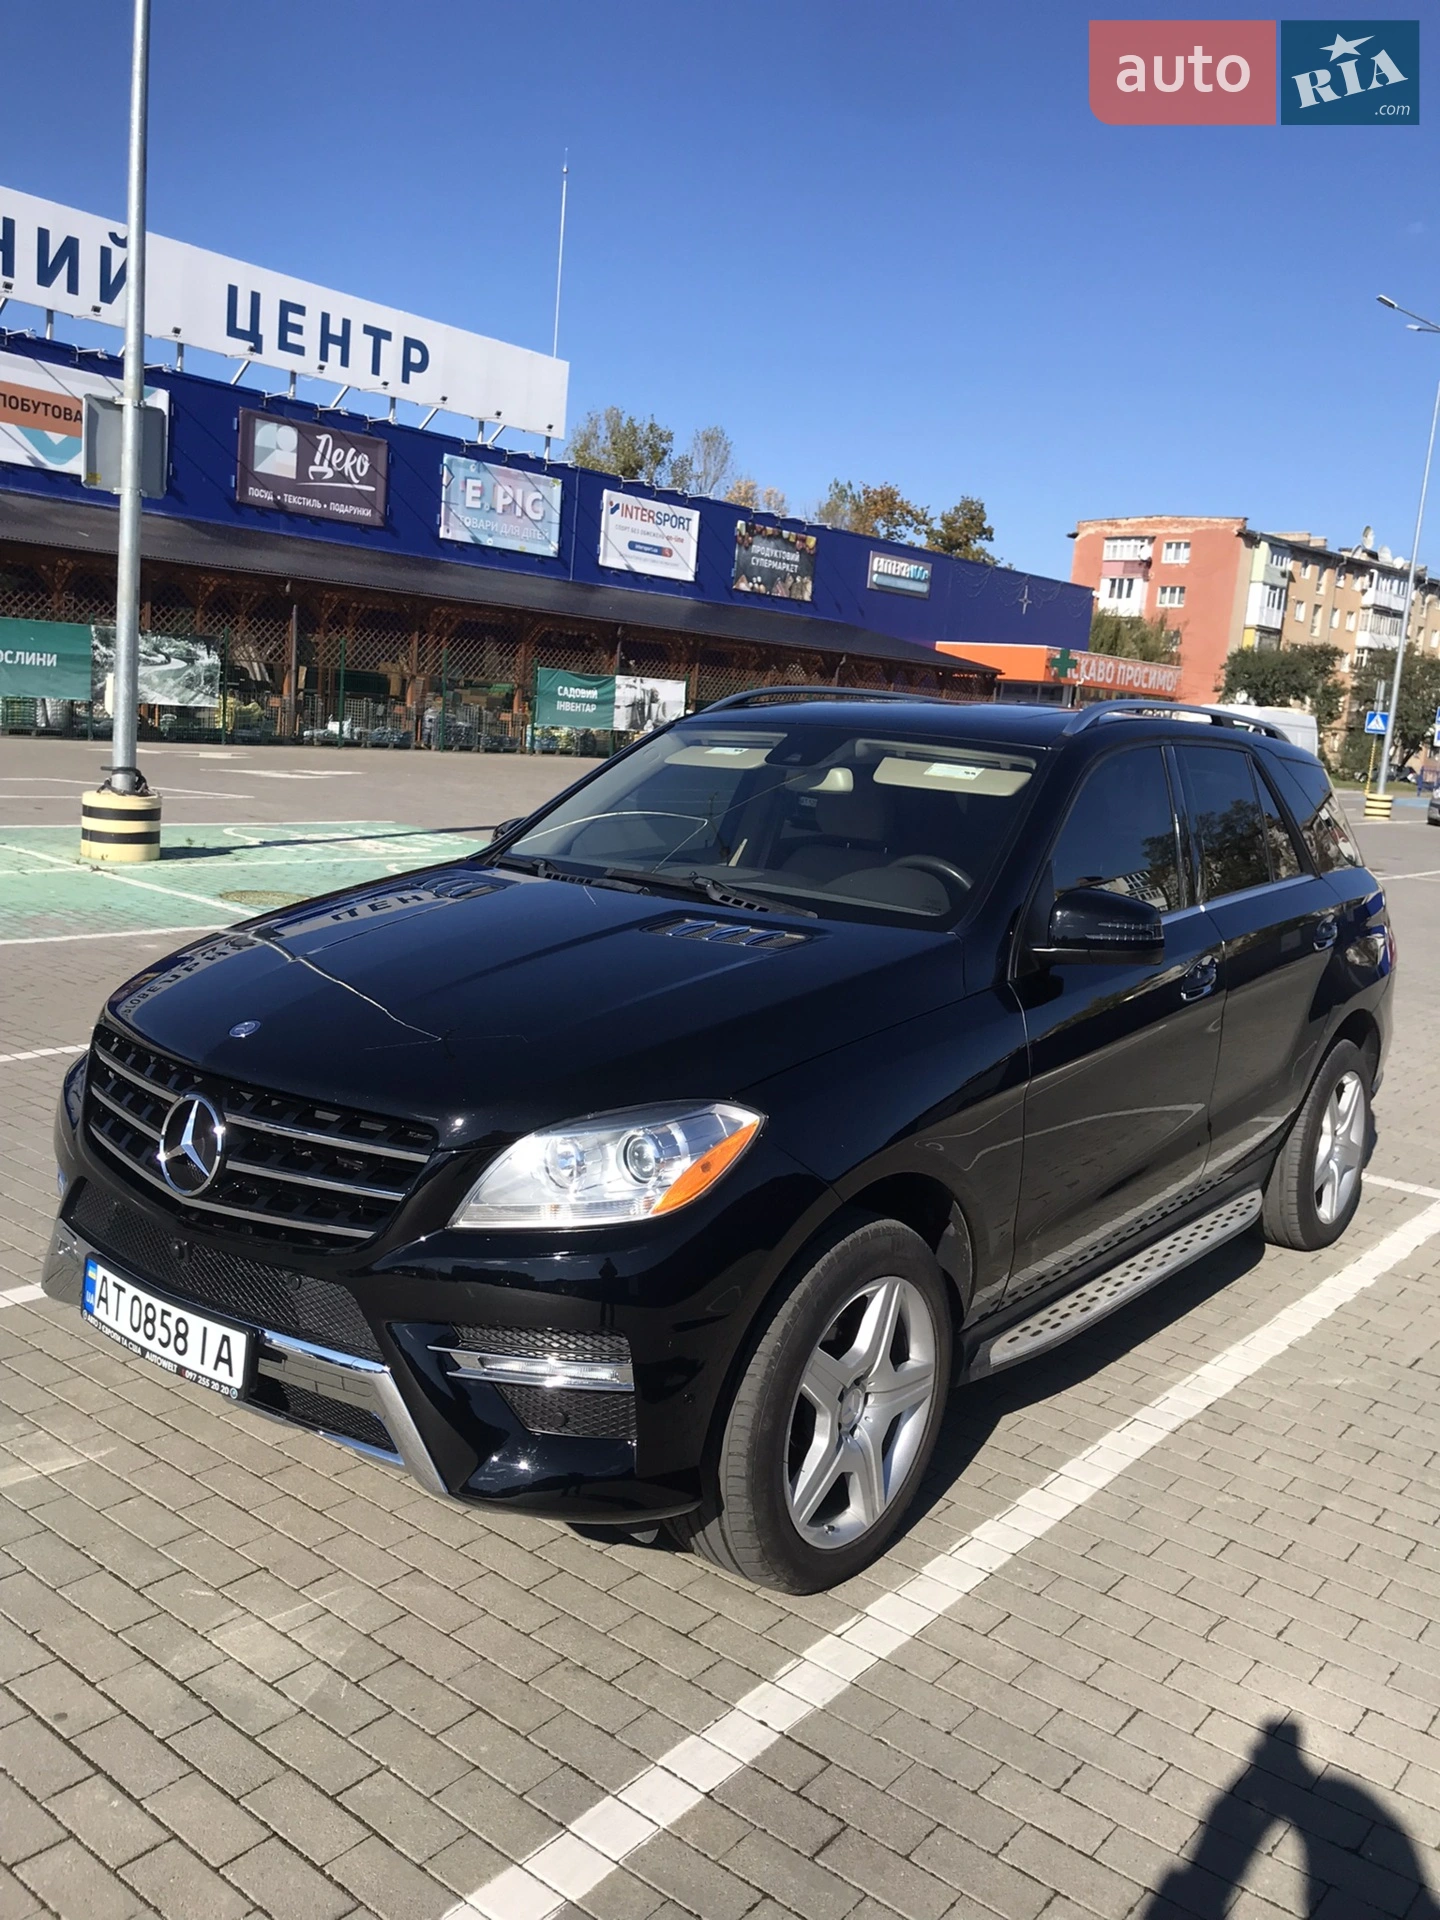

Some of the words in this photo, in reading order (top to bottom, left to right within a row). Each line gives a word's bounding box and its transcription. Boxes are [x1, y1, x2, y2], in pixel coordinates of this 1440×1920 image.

[226, 284, 430, 385] ЦЕНТР
[308, 433, 371, 483] Деко
[248, 487, 274, 501] ПОСУД
[283, 493, 322, 509] ТЕКСТИЛЬ
[329, 501, 372, 517] ПОДАРУНКИ
[460, 516, 498, 531] ТОВАРИ
[500, 523, 520, 536] ДЛЯ
[621, 503, 692, 532] INTERSPORT
[751, 545, 800, 562] ПРОДУКТОВИЙ
[751, 556, 799, 573] СУПЕРМАРКЕТ
[557, 685, 598, 699] САДОВИЙ
[556, 700, 597, 713] ІНВЕНТАР
[130, 1295, 189, 1356] 0858
